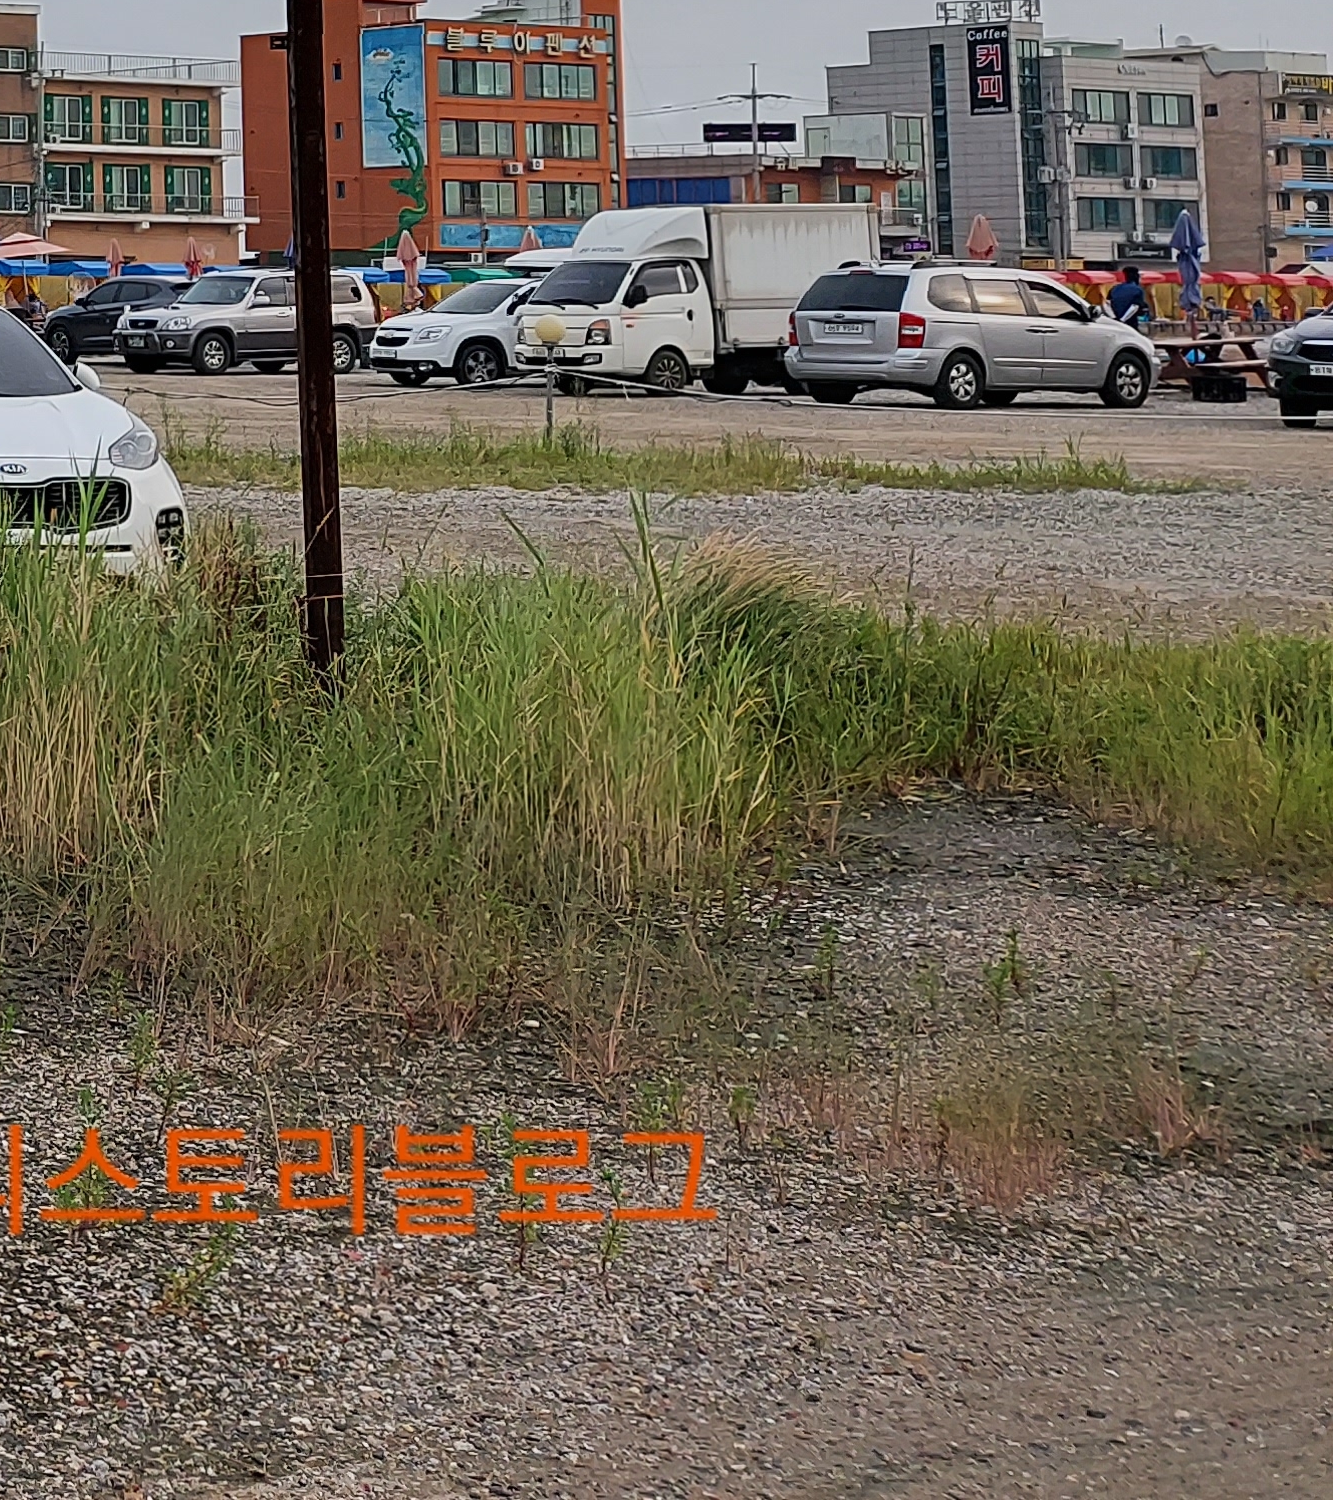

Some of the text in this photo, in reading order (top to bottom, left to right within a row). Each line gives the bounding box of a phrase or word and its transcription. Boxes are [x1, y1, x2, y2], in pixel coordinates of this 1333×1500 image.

[967, 29, 1008, 41] Coffee
[976, 43, 1004, 103] 커피
[2, 464, 25, 473] KIA
